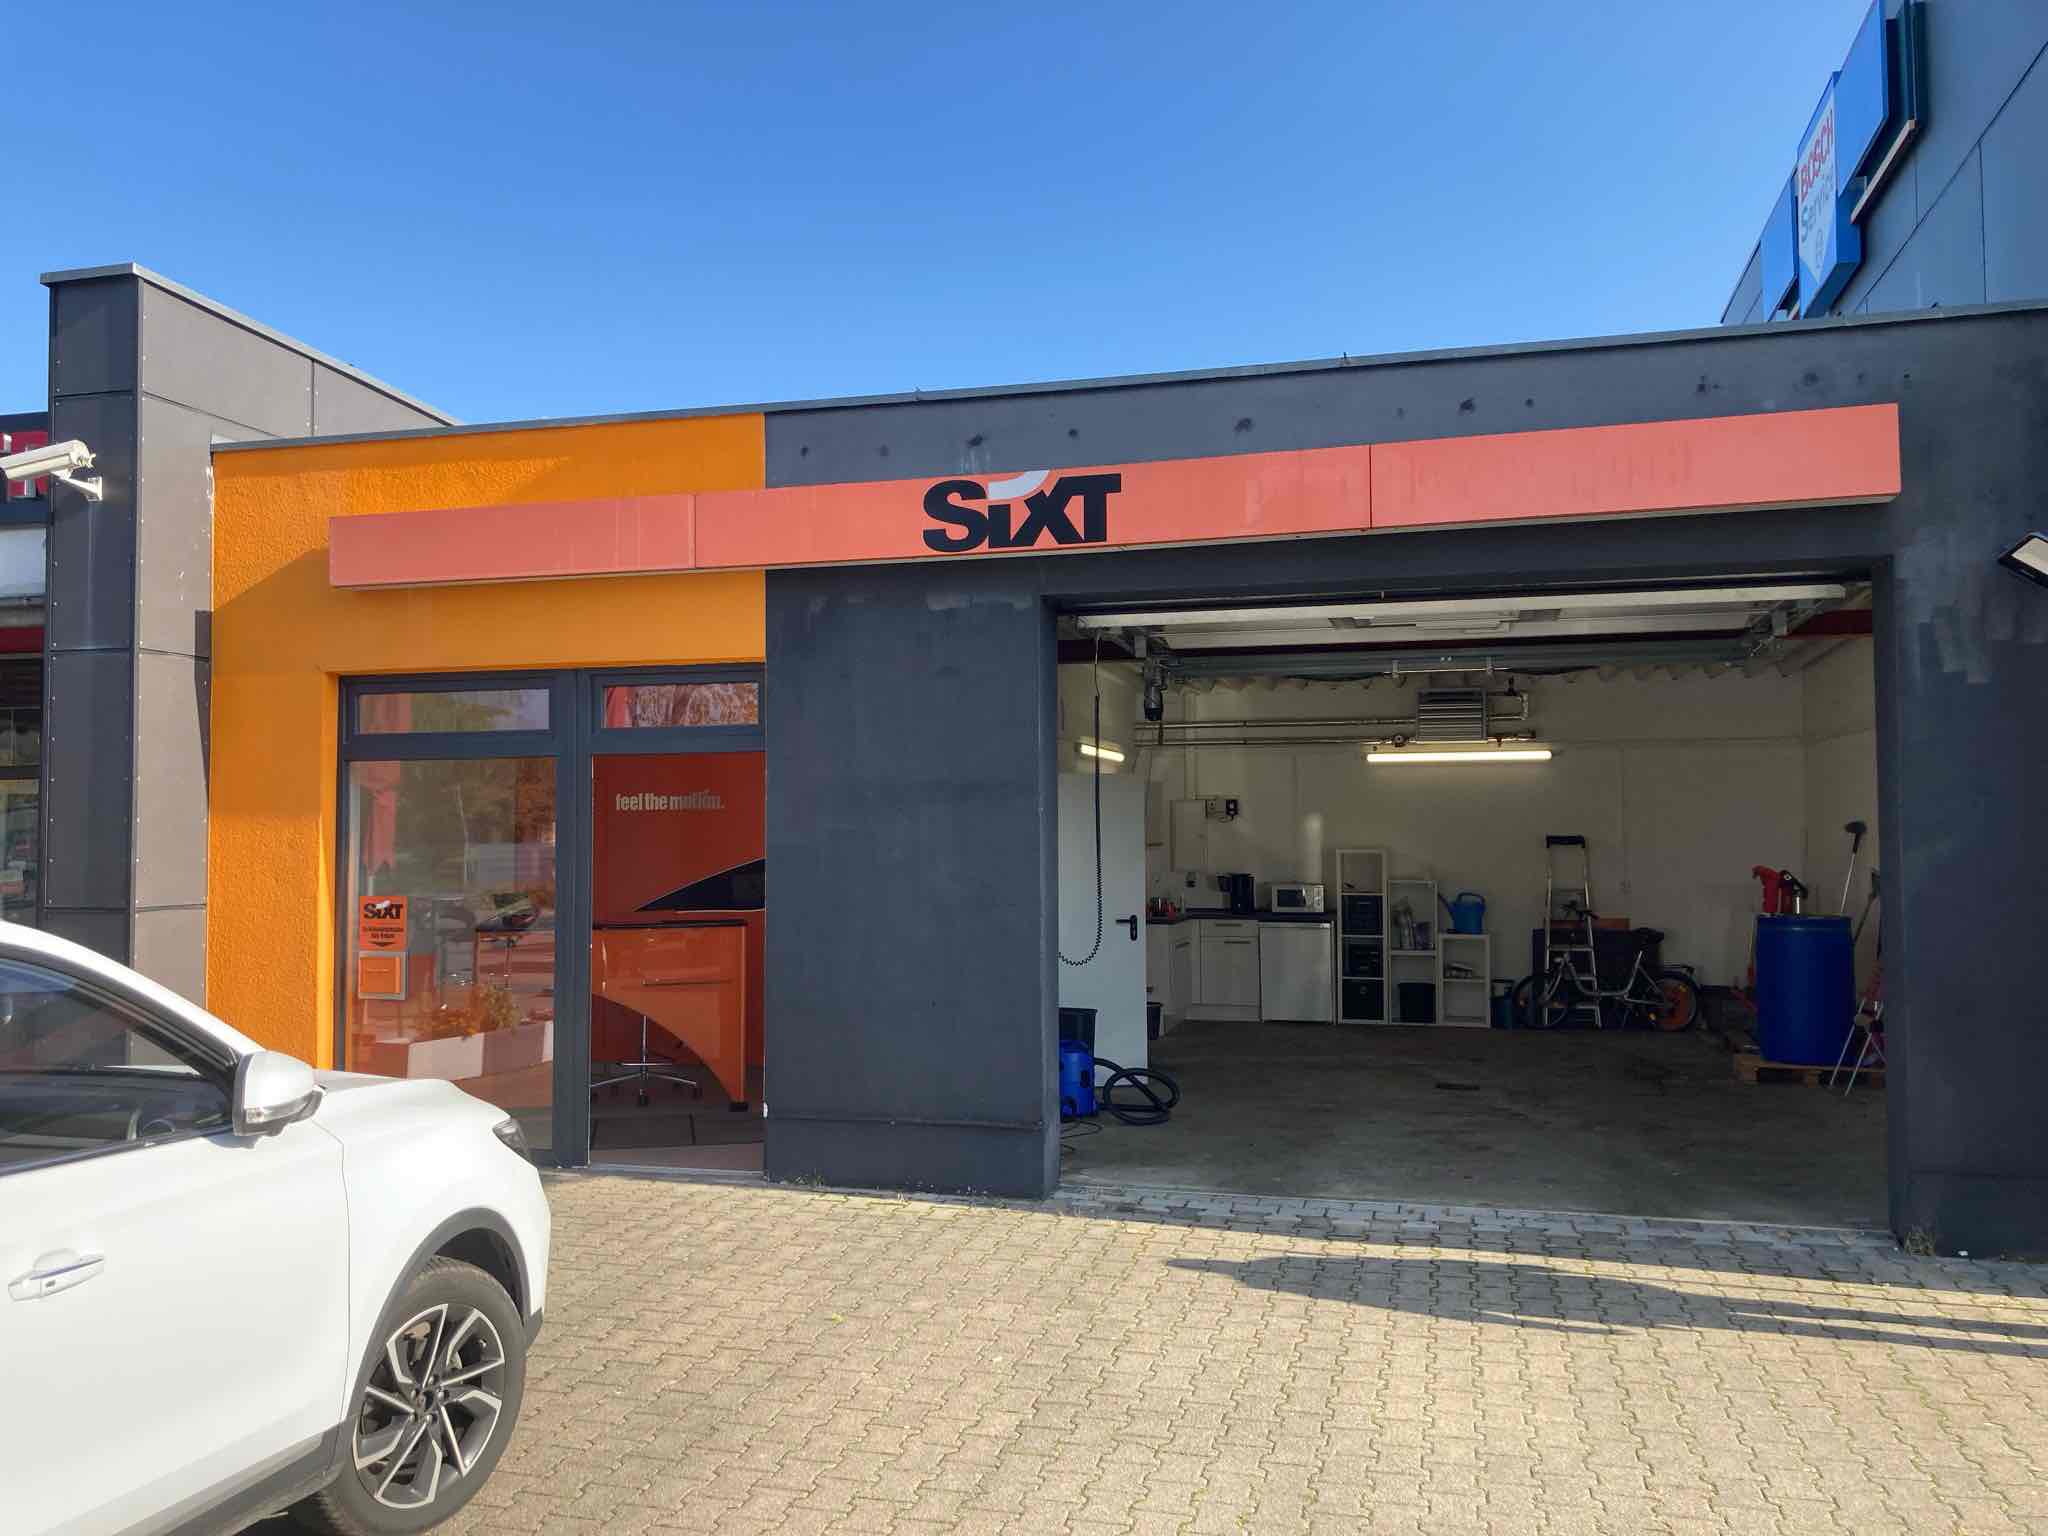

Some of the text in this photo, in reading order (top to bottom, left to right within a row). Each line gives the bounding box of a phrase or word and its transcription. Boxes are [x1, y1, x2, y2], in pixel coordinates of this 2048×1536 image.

[1800, 108, 1834, 202] BOSCH
[615, 793, 643, 811] feel
[644, 792, 668, 811] the
